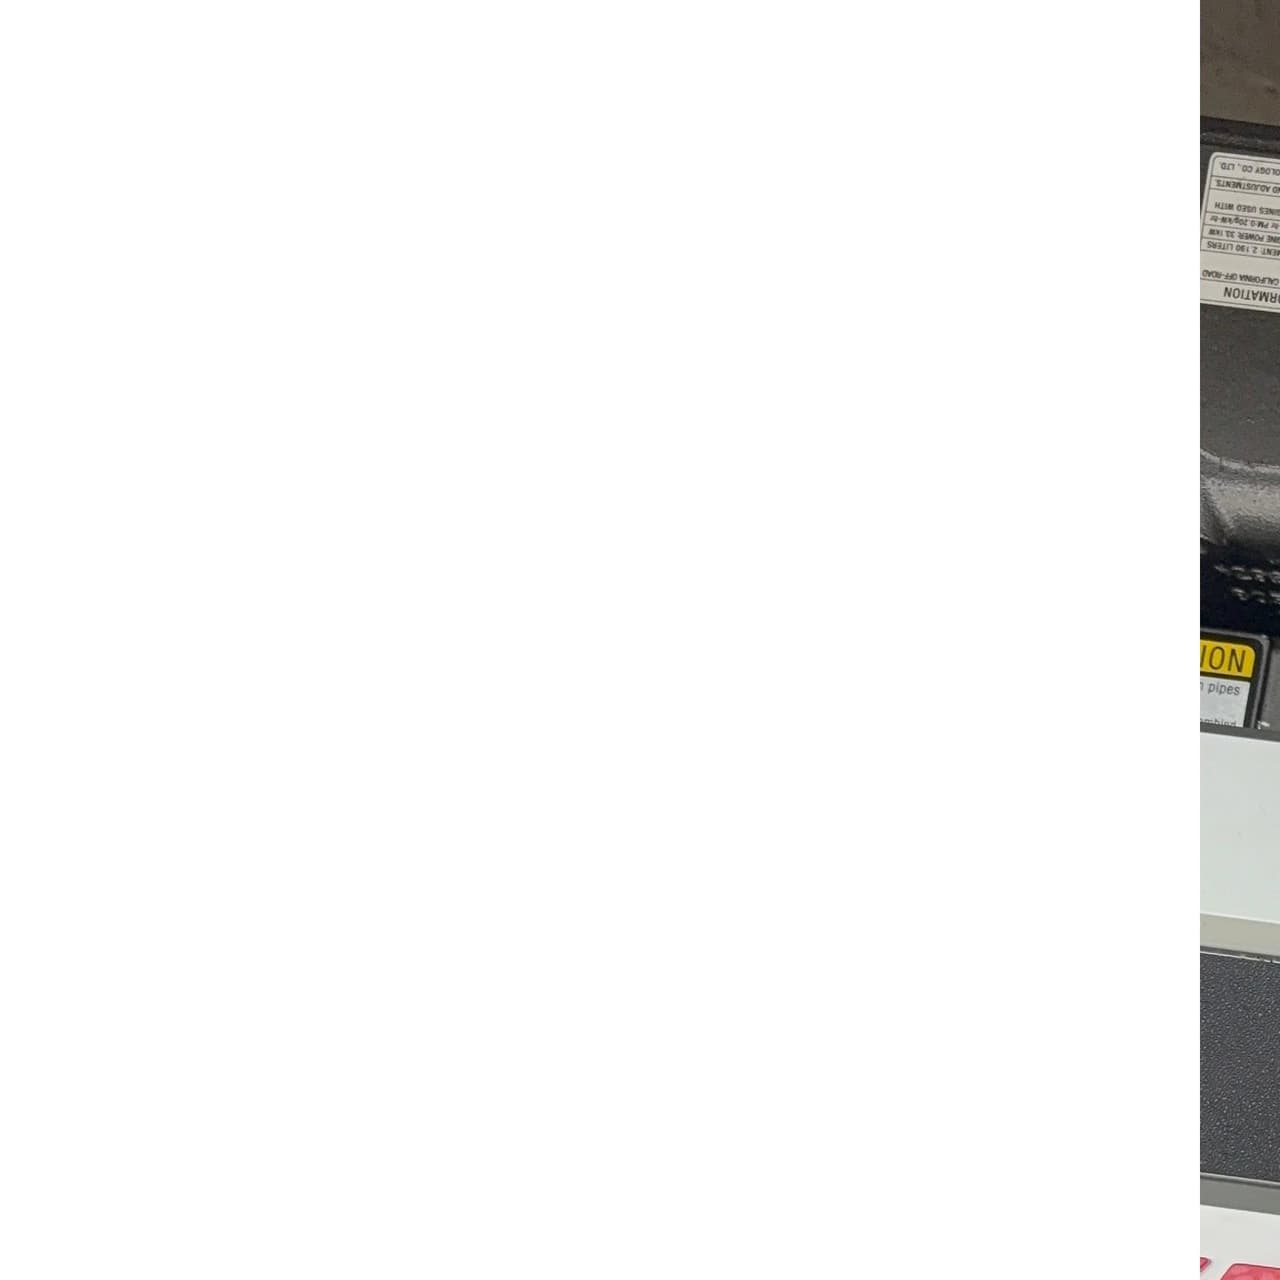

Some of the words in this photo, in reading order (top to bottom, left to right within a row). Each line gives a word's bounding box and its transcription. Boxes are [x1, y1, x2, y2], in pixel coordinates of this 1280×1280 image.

[1214, 200, 1234, 210] WITH
[1235, 203, 1256, 213] USED
[1206, 240, 1233, 251] LITERS
[1201, 270, 1237, 281] OFF-ROAD
[1238, 274, 1279, 286] CALIFORNIA
[1208, 683, 1241, 696] pipes
